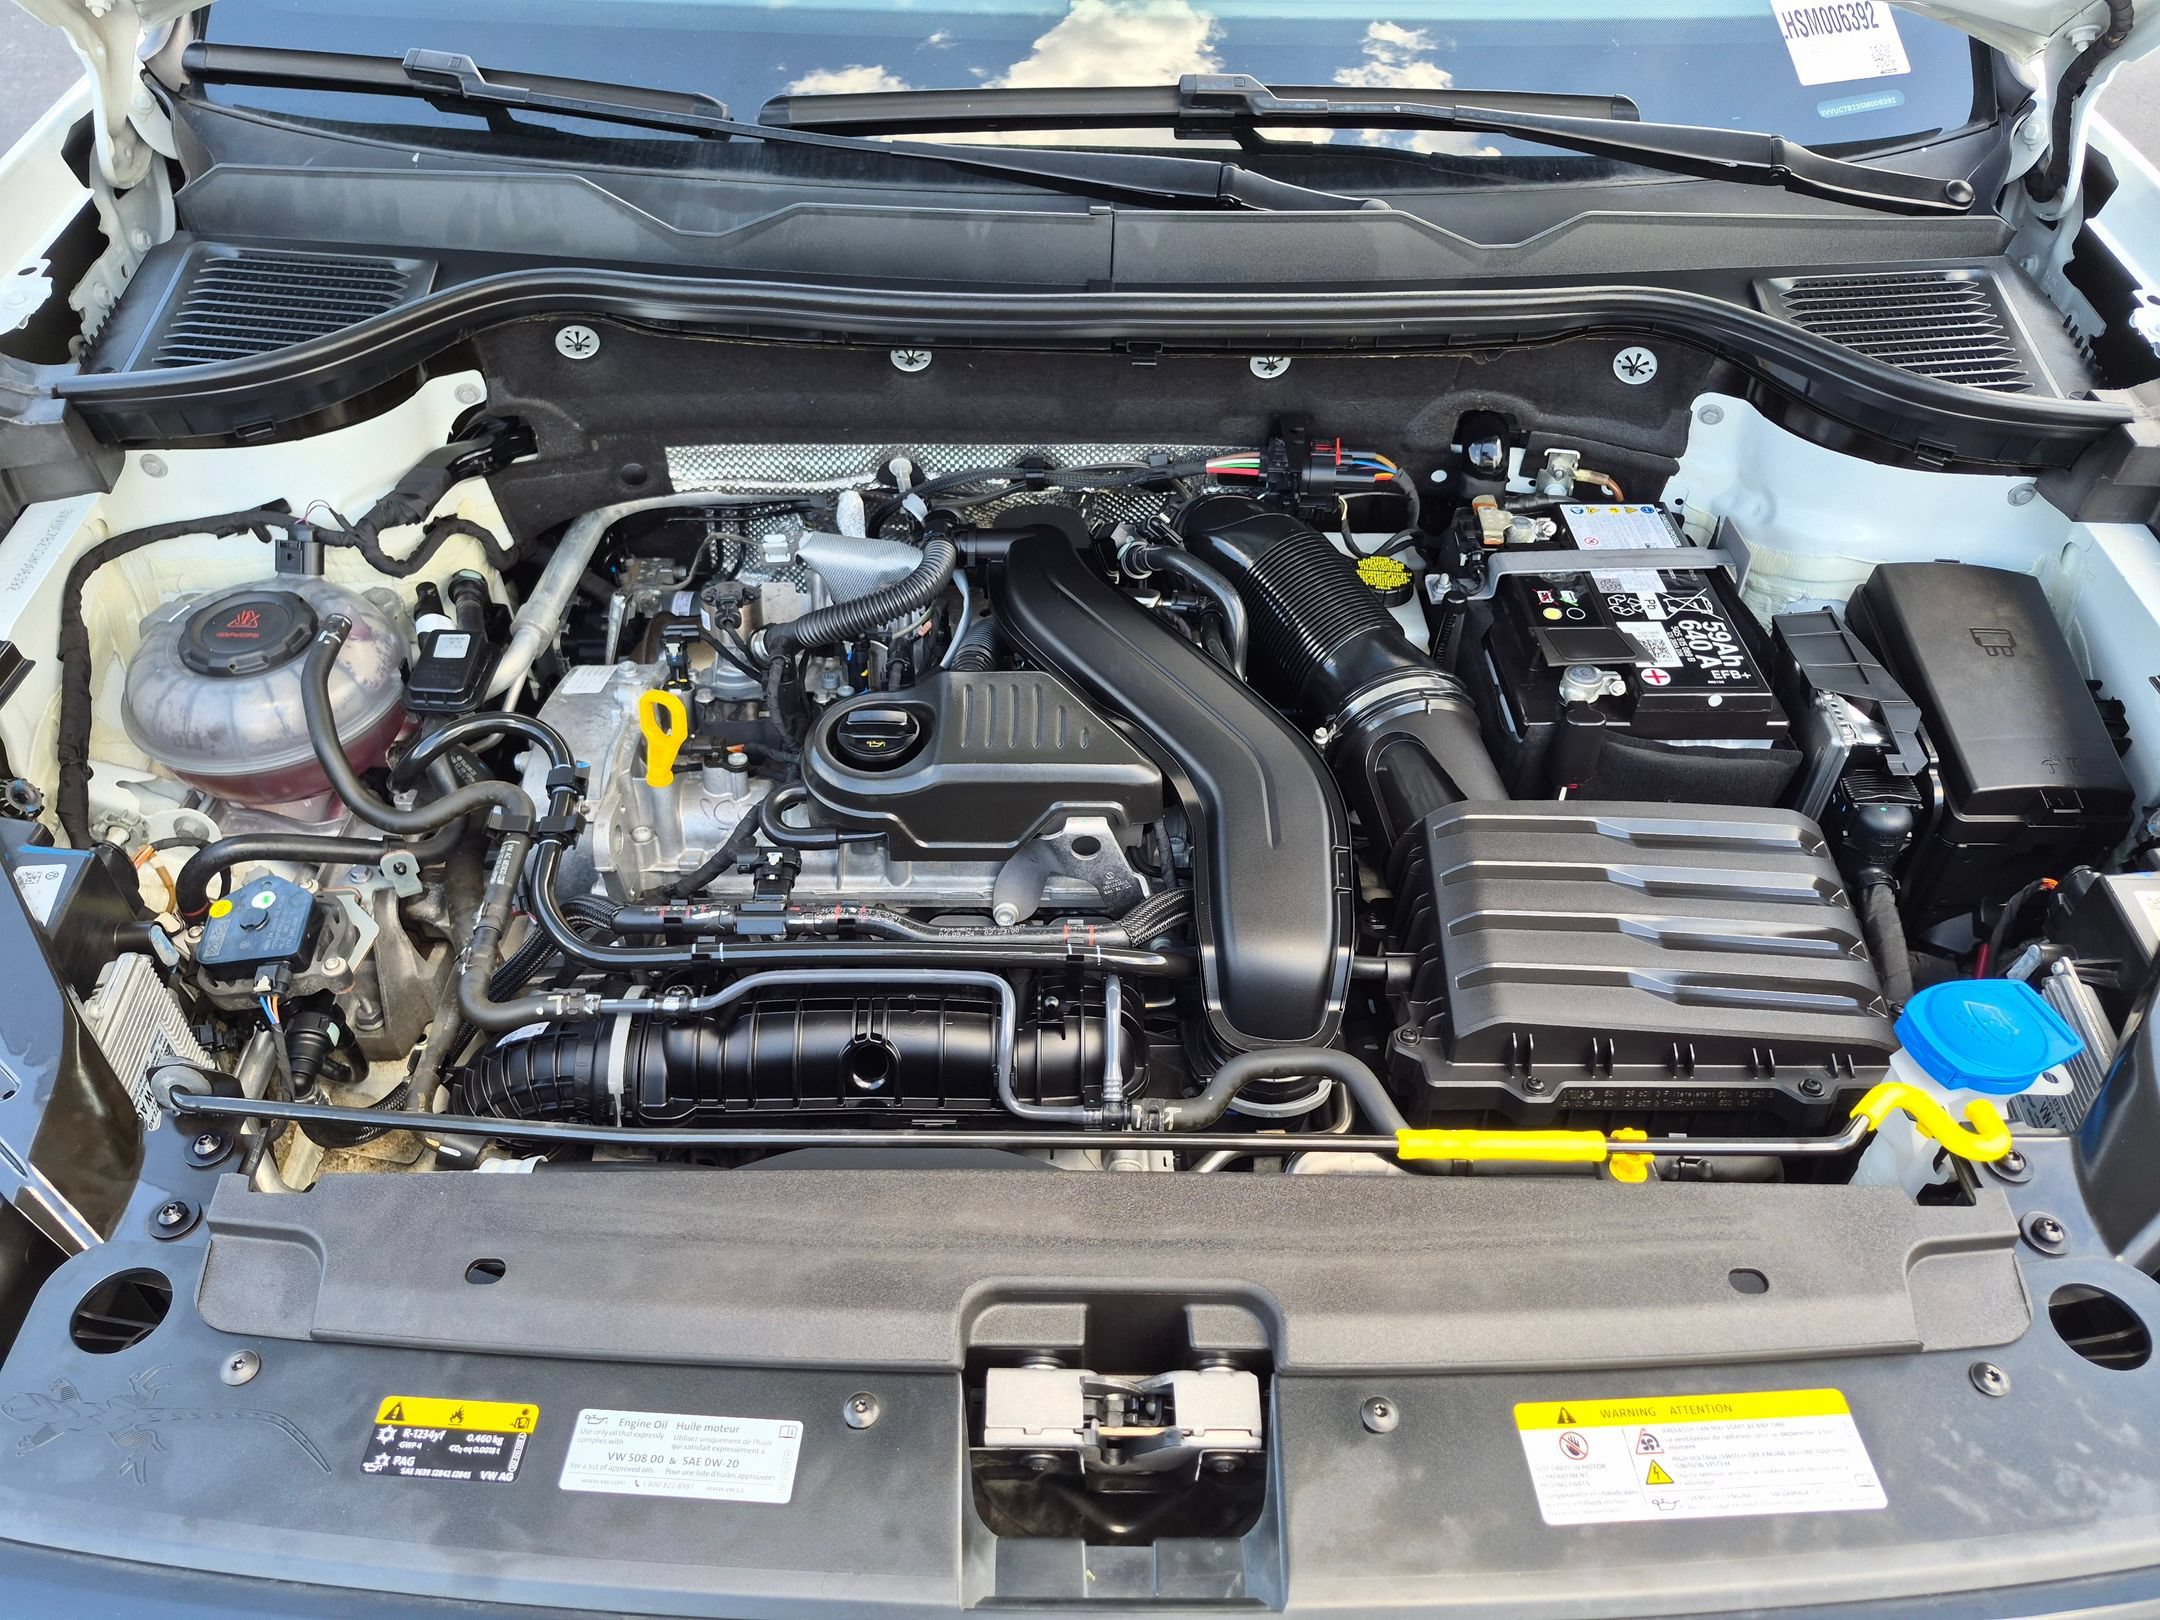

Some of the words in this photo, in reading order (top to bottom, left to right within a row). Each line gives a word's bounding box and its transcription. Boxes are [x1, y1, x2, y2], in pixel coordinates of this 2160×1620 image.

[1781, 0, 1880, 39] HSM006392
[1678, 619, 1714, 651] 640
[1702, 621, 1745, 667] 59Ah
[1695, 654, 1723, 669] A
[1710, 669, 1752, 679] EFB+
[1599, 1406, 1656, 1419] WARNING
[1669, 1403, 1733, 1416] ATTENTION
[618, 1418, 653, 1431] Engine
[653, 1420, 668, 1430] Oil
[676, 1421, 702, 1432] Huile
[704, 1424, 740, 1434] moteur
[466, 1433, 492, 1444] 0.460
[491, 1435, 504, 1447] kg
[594, 1430, 608, 1438] only
[618, 1430, 633, 1438] that
[633, 1432, 665, 1440] expressly
[577, 1438, 607, 1446] complies
[392, 1455, 416, 1467] PAG
[608, 1451, 627, 1461] VW
[628, 1452, 648, 1463] 508
[650, 1454, 665, 1464] 00
[669, 1457, 677, 1465] &
[682, 1456, 702, 1466] SAE
[704, 1457, 740, 1468] 0W-20
[608, 1465, 641, 1474] approved
[665, 1468, 681, 1476] Pour
[1582, 1463, 1606, 1471] MOTOR
[480, 1471, 498, 1481] VW
[498, 1472, 514, 1482] AG
